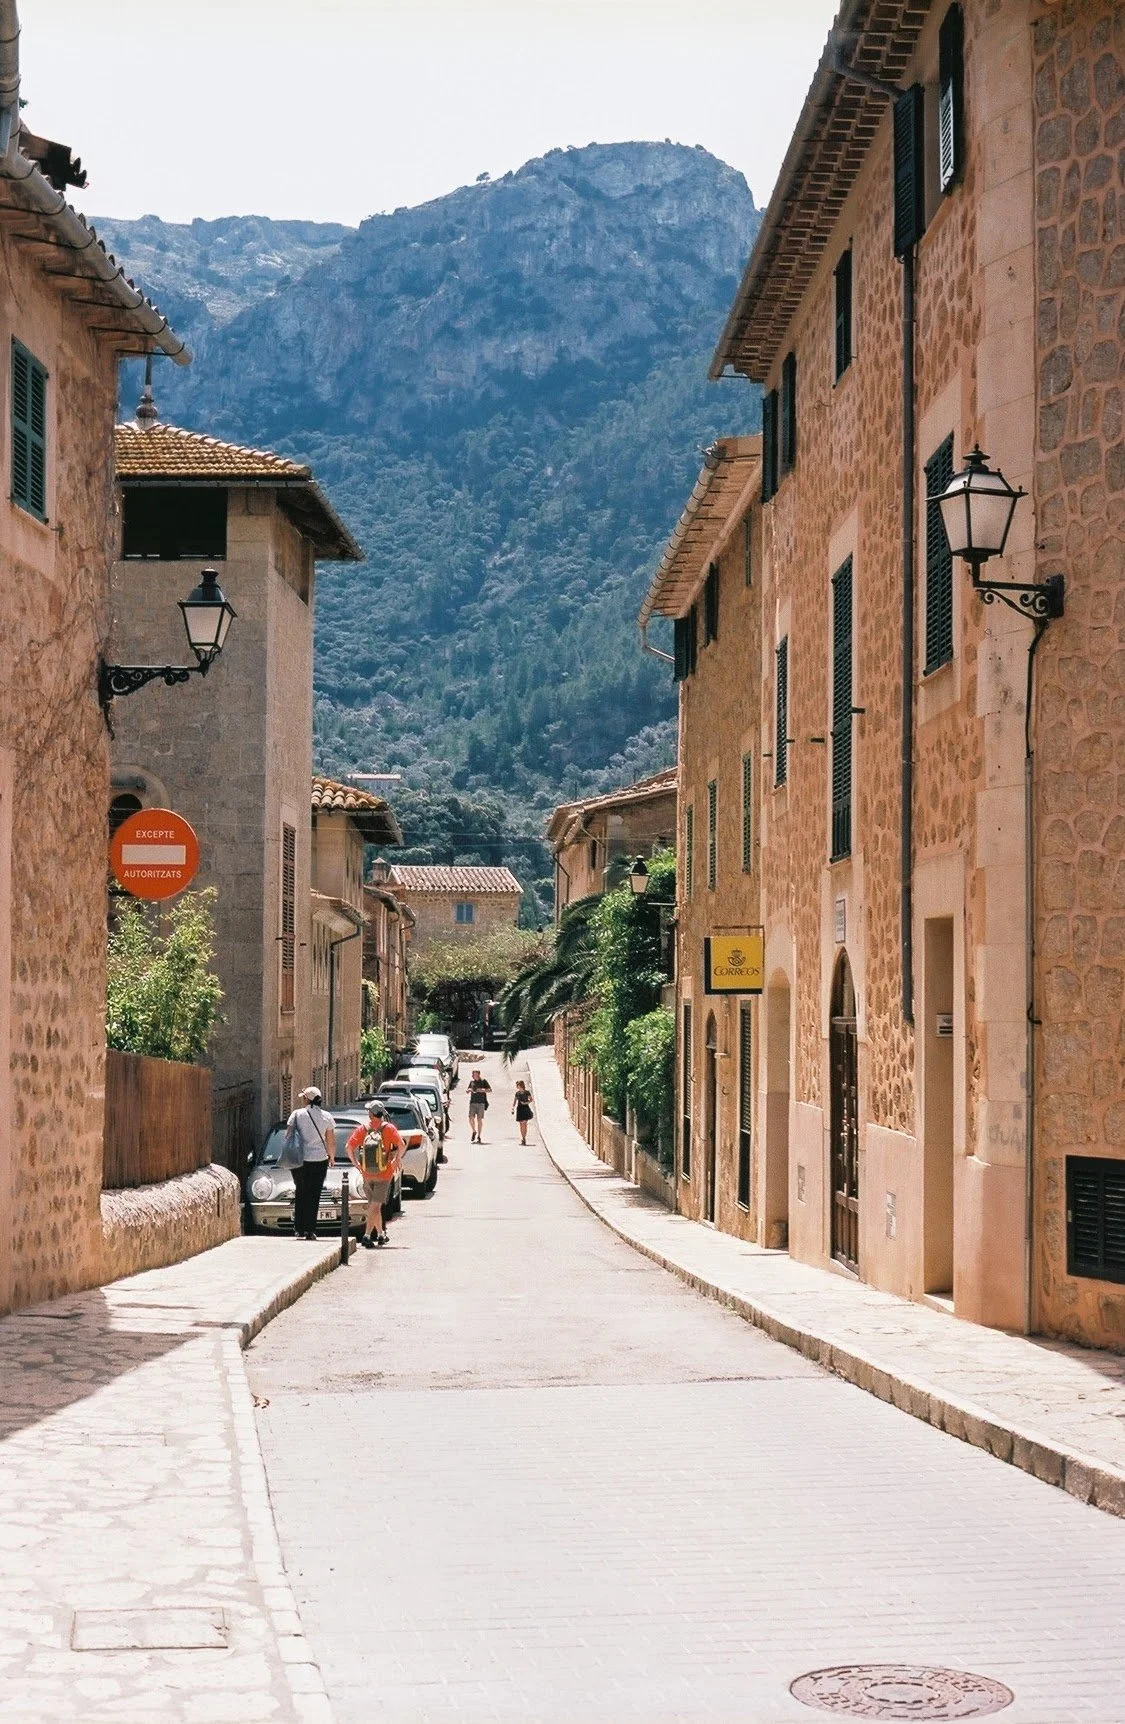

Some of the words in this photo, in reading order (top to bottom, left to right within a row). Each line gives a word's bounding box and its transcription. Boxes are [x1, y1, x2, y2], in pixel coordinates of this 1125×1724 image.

[135, 830, 175, 839] EXCEPTE
[123, 869, 182, 879] AUTORITZATS
[713, 965, 760, 977] CORREOS
